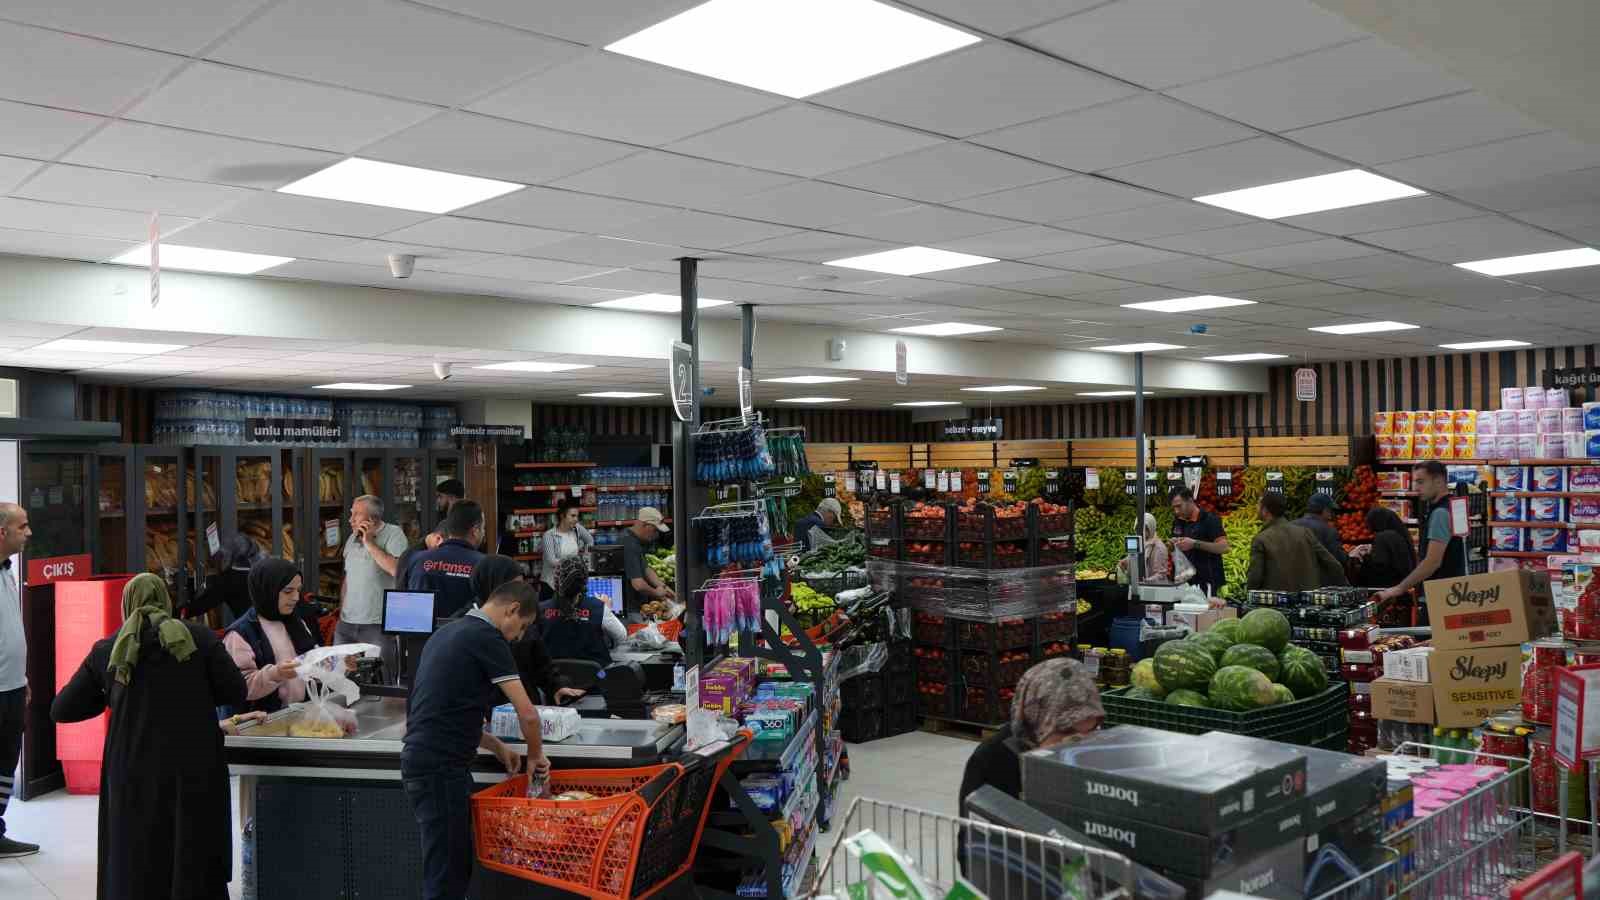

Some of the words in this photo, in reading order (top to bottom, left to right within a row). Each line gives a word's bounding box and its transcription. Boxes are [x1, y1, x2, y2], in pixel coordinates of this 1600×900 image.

[254, 425, 280, 436] unlu
[284, 426, 341, 437] mamülleri
[43, 562, 75, 580] ÇIKIŞ
[1446, 581, 1500, 607] Sleepy
[1450, 655, 1508, 683] Sleepy
[1451, 689, 1515, 703] SENSITIVE
[1084, 780, 1138, 807] borart
[1083, 820, 1136, 849] borart
